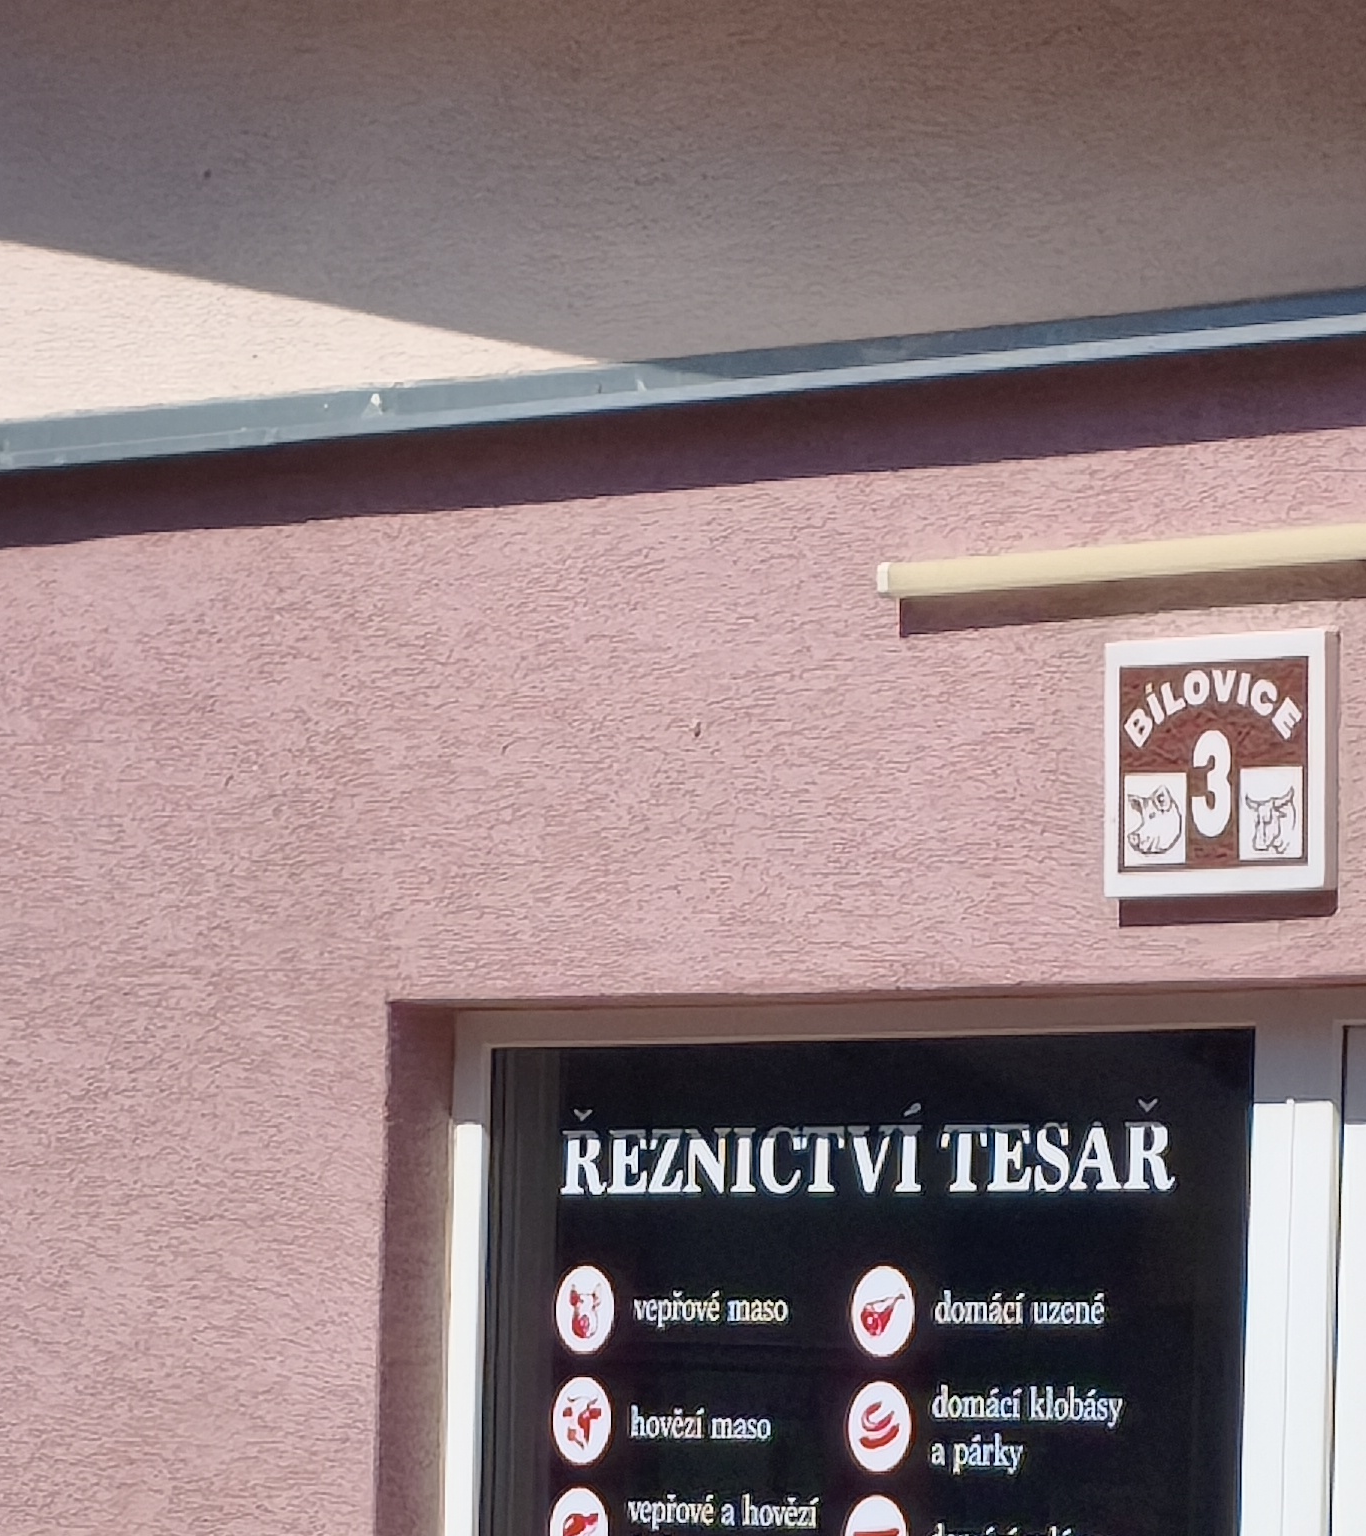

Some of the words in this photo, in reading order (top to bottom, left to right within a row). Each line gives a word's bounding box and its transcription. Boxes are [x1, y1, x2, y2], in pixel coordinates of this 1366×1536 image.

[1123, 669, 1302, 748] BÍLOVICE
[1191, 729, 1232, 837] 3
[559, 1103, 922, 1196] ŘEZNICTVÍ
[940, 1098, 1176, 1193] TESAŘ
[633, 1289, 720, 1329] vepřové
[726, 1298, 789, 1325] maso
[934, 1289, 1026, 1325] domácí
[1029, 1292, 1105, 1325] uzené
[630, 1404, 705, 1439] hovězí
[709, 1417, 772, 1442] maso
[931, 1385, 1023, 1421] domácí
[1028, 1385, 1123, 1429] klobásy
[931, 1442, 946, 1467] a
[952, 1433, 1024, 1475] párky
[627, 1493, 715, 1532] vepřové
[720, 1503, 736, 1527] a
[741, 1492, 820, 1529] hovězí
